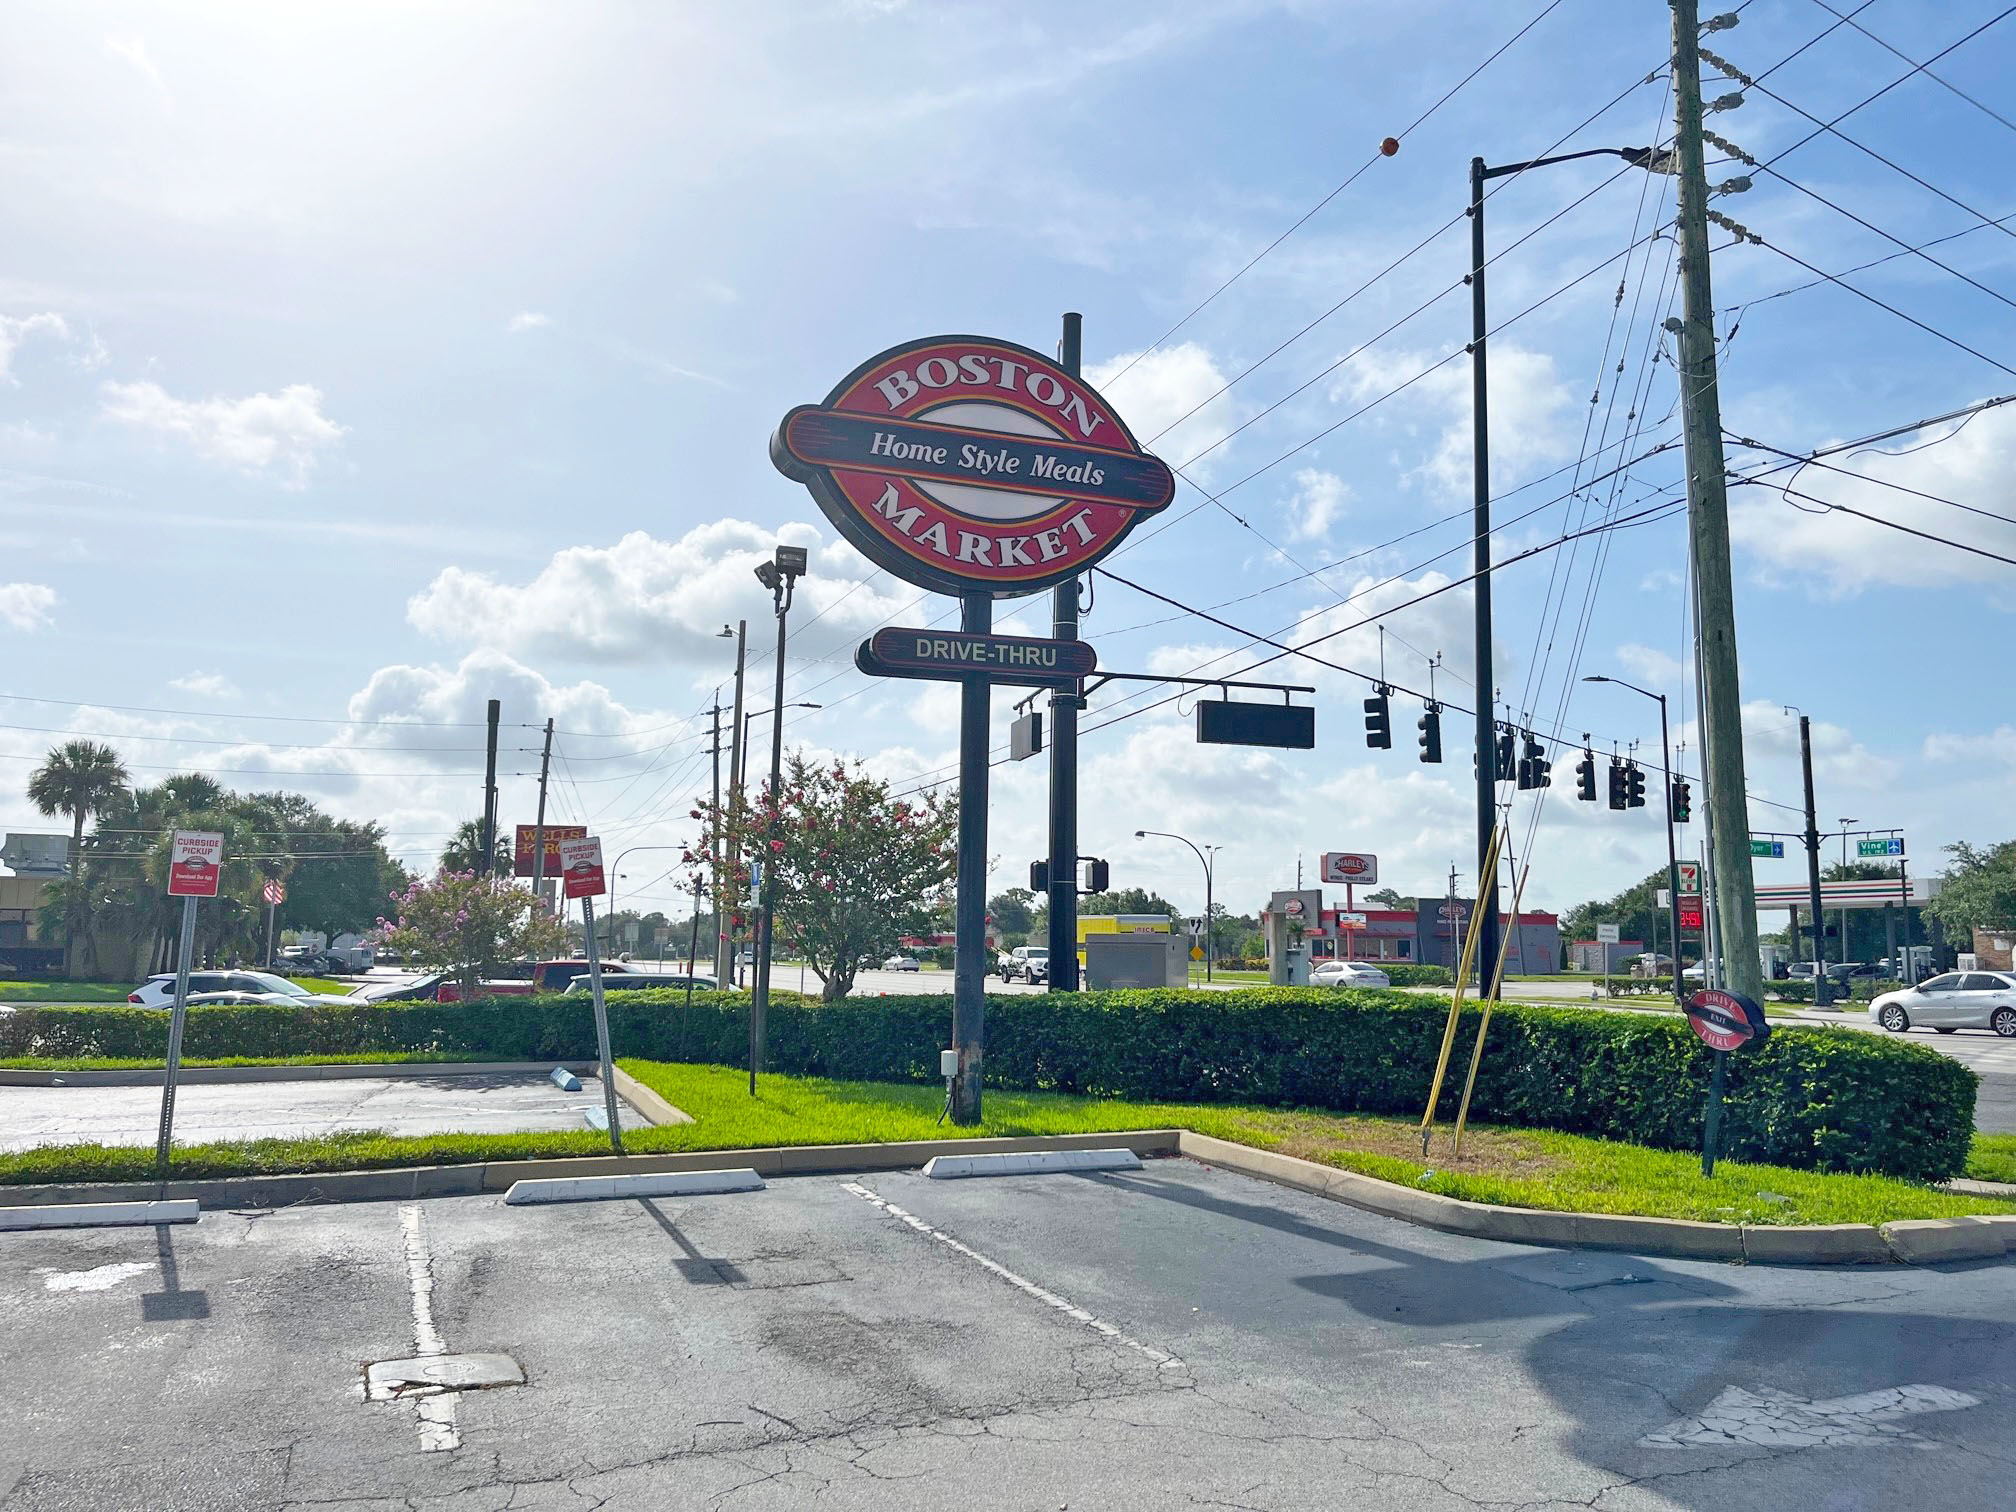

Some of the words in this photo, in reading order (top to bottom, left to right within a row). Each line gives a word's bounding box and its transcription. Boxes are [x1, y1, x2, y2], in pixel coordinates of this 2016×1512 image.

[873, 355, 1104, 437] BOSTON
[870, 432, 947, 465] Home
[958, 444, 1020, 475] Style
[1030, 454, 1105, 486] Meals
[871, 481, 1097, 568] MARKET
[916, 638, 1056, 666] DRIVE-THRU
[177, 838, 220, 847] CURBSIDE
[182, 847, 213, 855] PICKUP
[563, 843, 599, 854] CURBSIDE
[1860, 842, 1881, 850] Vine
[568, 851, 595, 861] PICKUP
[1681, 867, 1696, 891] 7
[1705, 993, 1735, 1010] DRIVE
[1701, 1029, 1730, 1047] THRU
